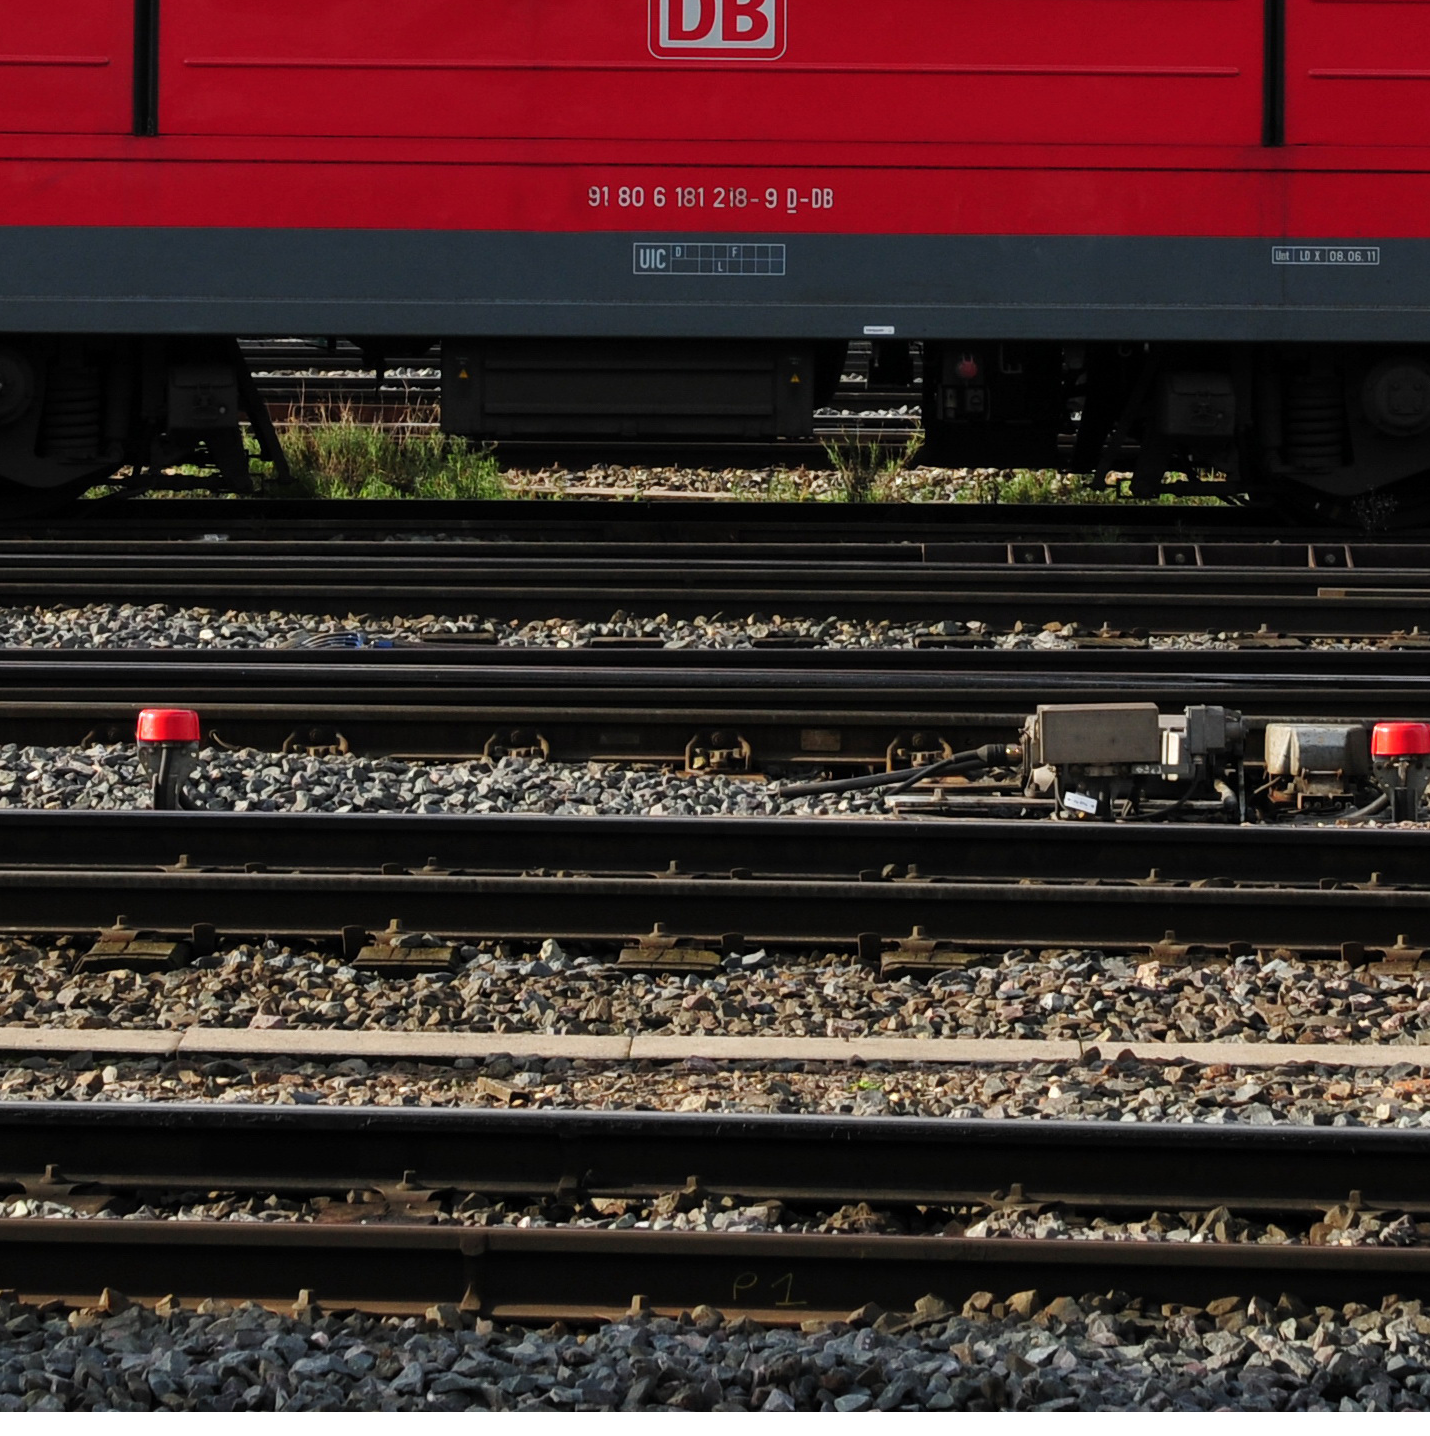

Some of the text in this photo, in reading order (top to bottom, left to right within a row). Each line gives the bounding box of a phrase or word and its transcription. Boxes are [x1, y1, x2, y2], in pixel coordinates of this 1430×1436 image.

[588, 186, 609, 207] 91
[618, 186, 644, 207] 80
[654, 187, 666, 207] 6
[675, 187, 704, 208] 181
[786, 188, 834, 214] D-DB
[675, 247, 738, 258] D F
[1314, 251, 1321, 261] X
[640, 248, 666, 269] UIC
[718, 262, 723, 272] L
